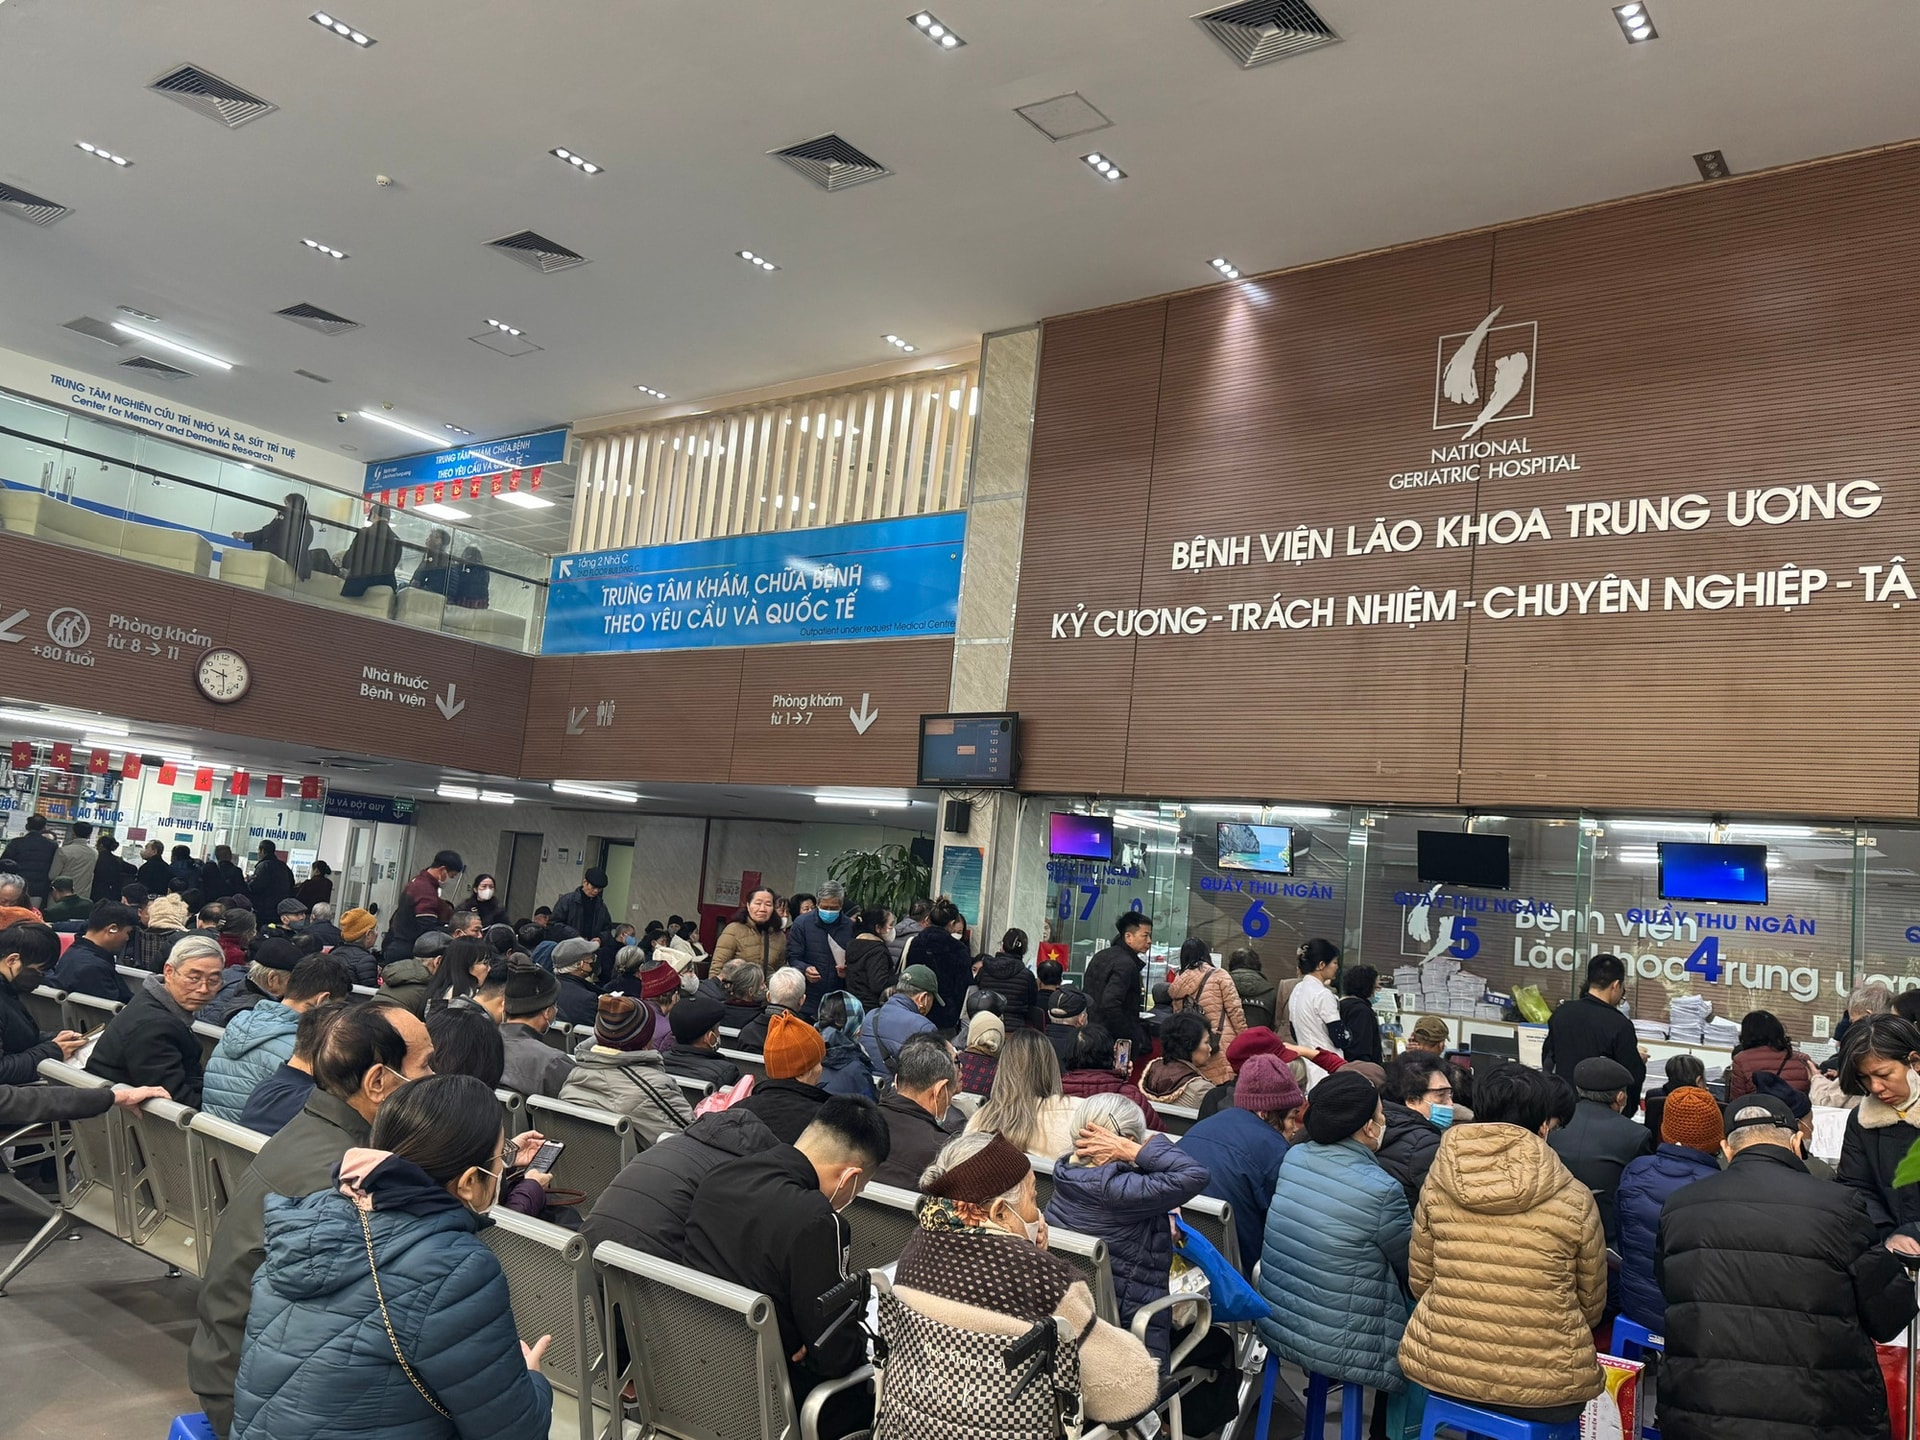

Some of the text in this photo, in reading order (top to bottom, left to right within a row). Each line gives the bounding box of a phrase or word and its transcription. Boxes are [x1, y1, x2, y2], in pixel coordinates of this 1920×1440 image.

[50, 374, 296, 460] TRUNG TÂM NGHIÊN CỨU TRÍ NHỚ VÀ SA SÚT TRÍ TUỆ
[72, 394, 274, 462] Center for Memory and Dementia Research
[436, 453, 456, 464] TRUNG
[1431, 437, 1532, 464] NATIONAL
[438, 468, 453, 479] THEO
[1389, 453, 1581, 490] GERIATRIC HOSPITAL
[1171, 479, 1883, 574] BỆNH VIỆN LÃO KHOA TRUNG ƯƠNG
[590, 568, 607, 577] FLOOR
[598, 557, 603, 567] 2
[604, 556, 620, 565] Nhà
[621, 553, 629, 564] C
[601, 563, 862, 607] TRUNG TÂM KHÁM, CHỮA BỆNH
[604, 588, 858, 634] THEO YÊU CẦU VÀ QUỐC TẾ
[1051, 603, 1088, 639] KỶ
[1093, 606, 1208, 638] CƯƠNG
[1228, 592, 1335, 631] TRÁCH
[1346, 585, 1457, 629] NHIỆM
[1483, 573, 1650, 620] CHUYÊN
[1663, 562, 1828, 612] NGHIỆP
[108, 613, 212, 648] Phòng khám
[800, 619, 956, 637] Outpatient under request Medical Centre
[31, 645, 95, 667] +80 tuổi
[107, 633, 179, 660] từ 8 11
[362, 665, 430, 690] Nhà thuốc
[360, 683, 426, 708] Bệnh viện
[772, 692, 843, 710] Phòng khám
[770, 711, 813, 725] từ 1 7
[158, 817, 214, 832] NƠI THU TIỀN
[277, 812, 283, 826] 1
[249, 826, 307, 842] NƠI NHẬN ĐƠN
[1079, 885, 1101, 921] 7
[1250, 881, 1278, 896] THU
[1283, 881, 1333, 900] NGÂN
[1241, 899, 1270, 939] 6
[1452, 896, 1488, 912] THU
[1494, 896, 1554, 917] NGÂN
[1626, 902, 1816, 936] QUẦY THU NGÂN
[1449, 915, 1481, 960] 5
[1514, 936, 1582, 971] Lão
[1684, 935, 1723, 982] 4
